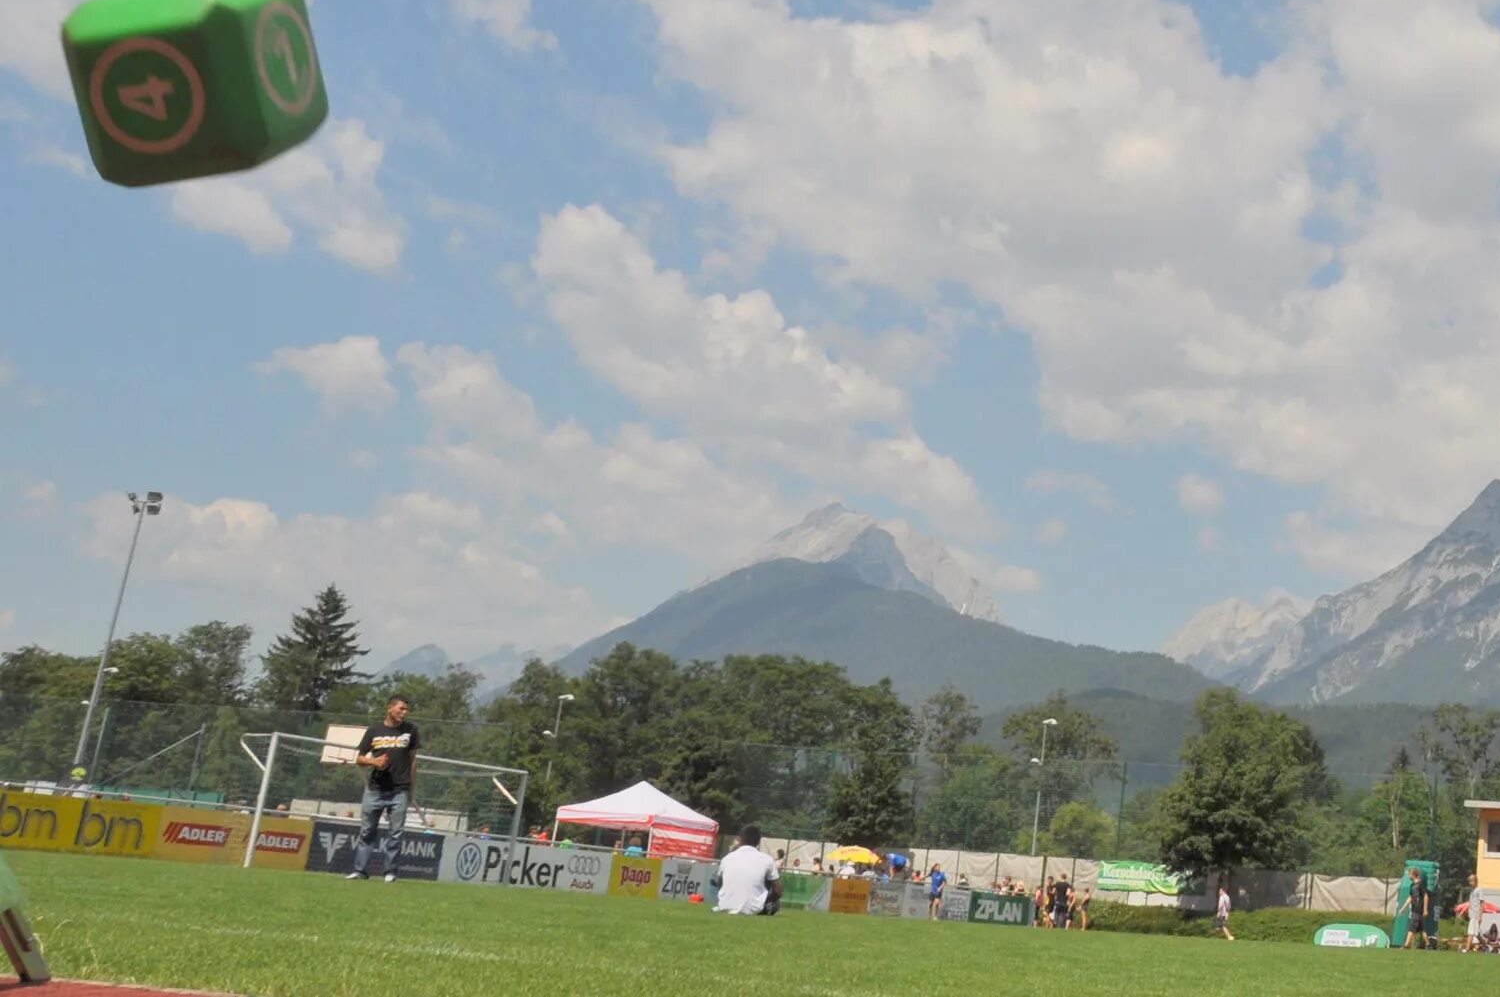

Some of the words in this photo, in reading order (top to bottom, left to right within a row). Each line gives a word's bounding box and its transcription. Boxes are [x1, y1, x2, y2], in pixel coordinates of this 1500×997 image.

[117, 75, 174, 122] 4
[73, 799, 144, 851] bm
[177, 826, 227, 843] ADLER
[256, 833, 300, 850] ADLER
[482, 846, 565, 888] Picker
[620, 866, 652, 888] pago
[570, 878, 595, 890] Audi
[661, 873, 701, 900] Zipfer
[974, 899, 1024, 923] ZPLAN
